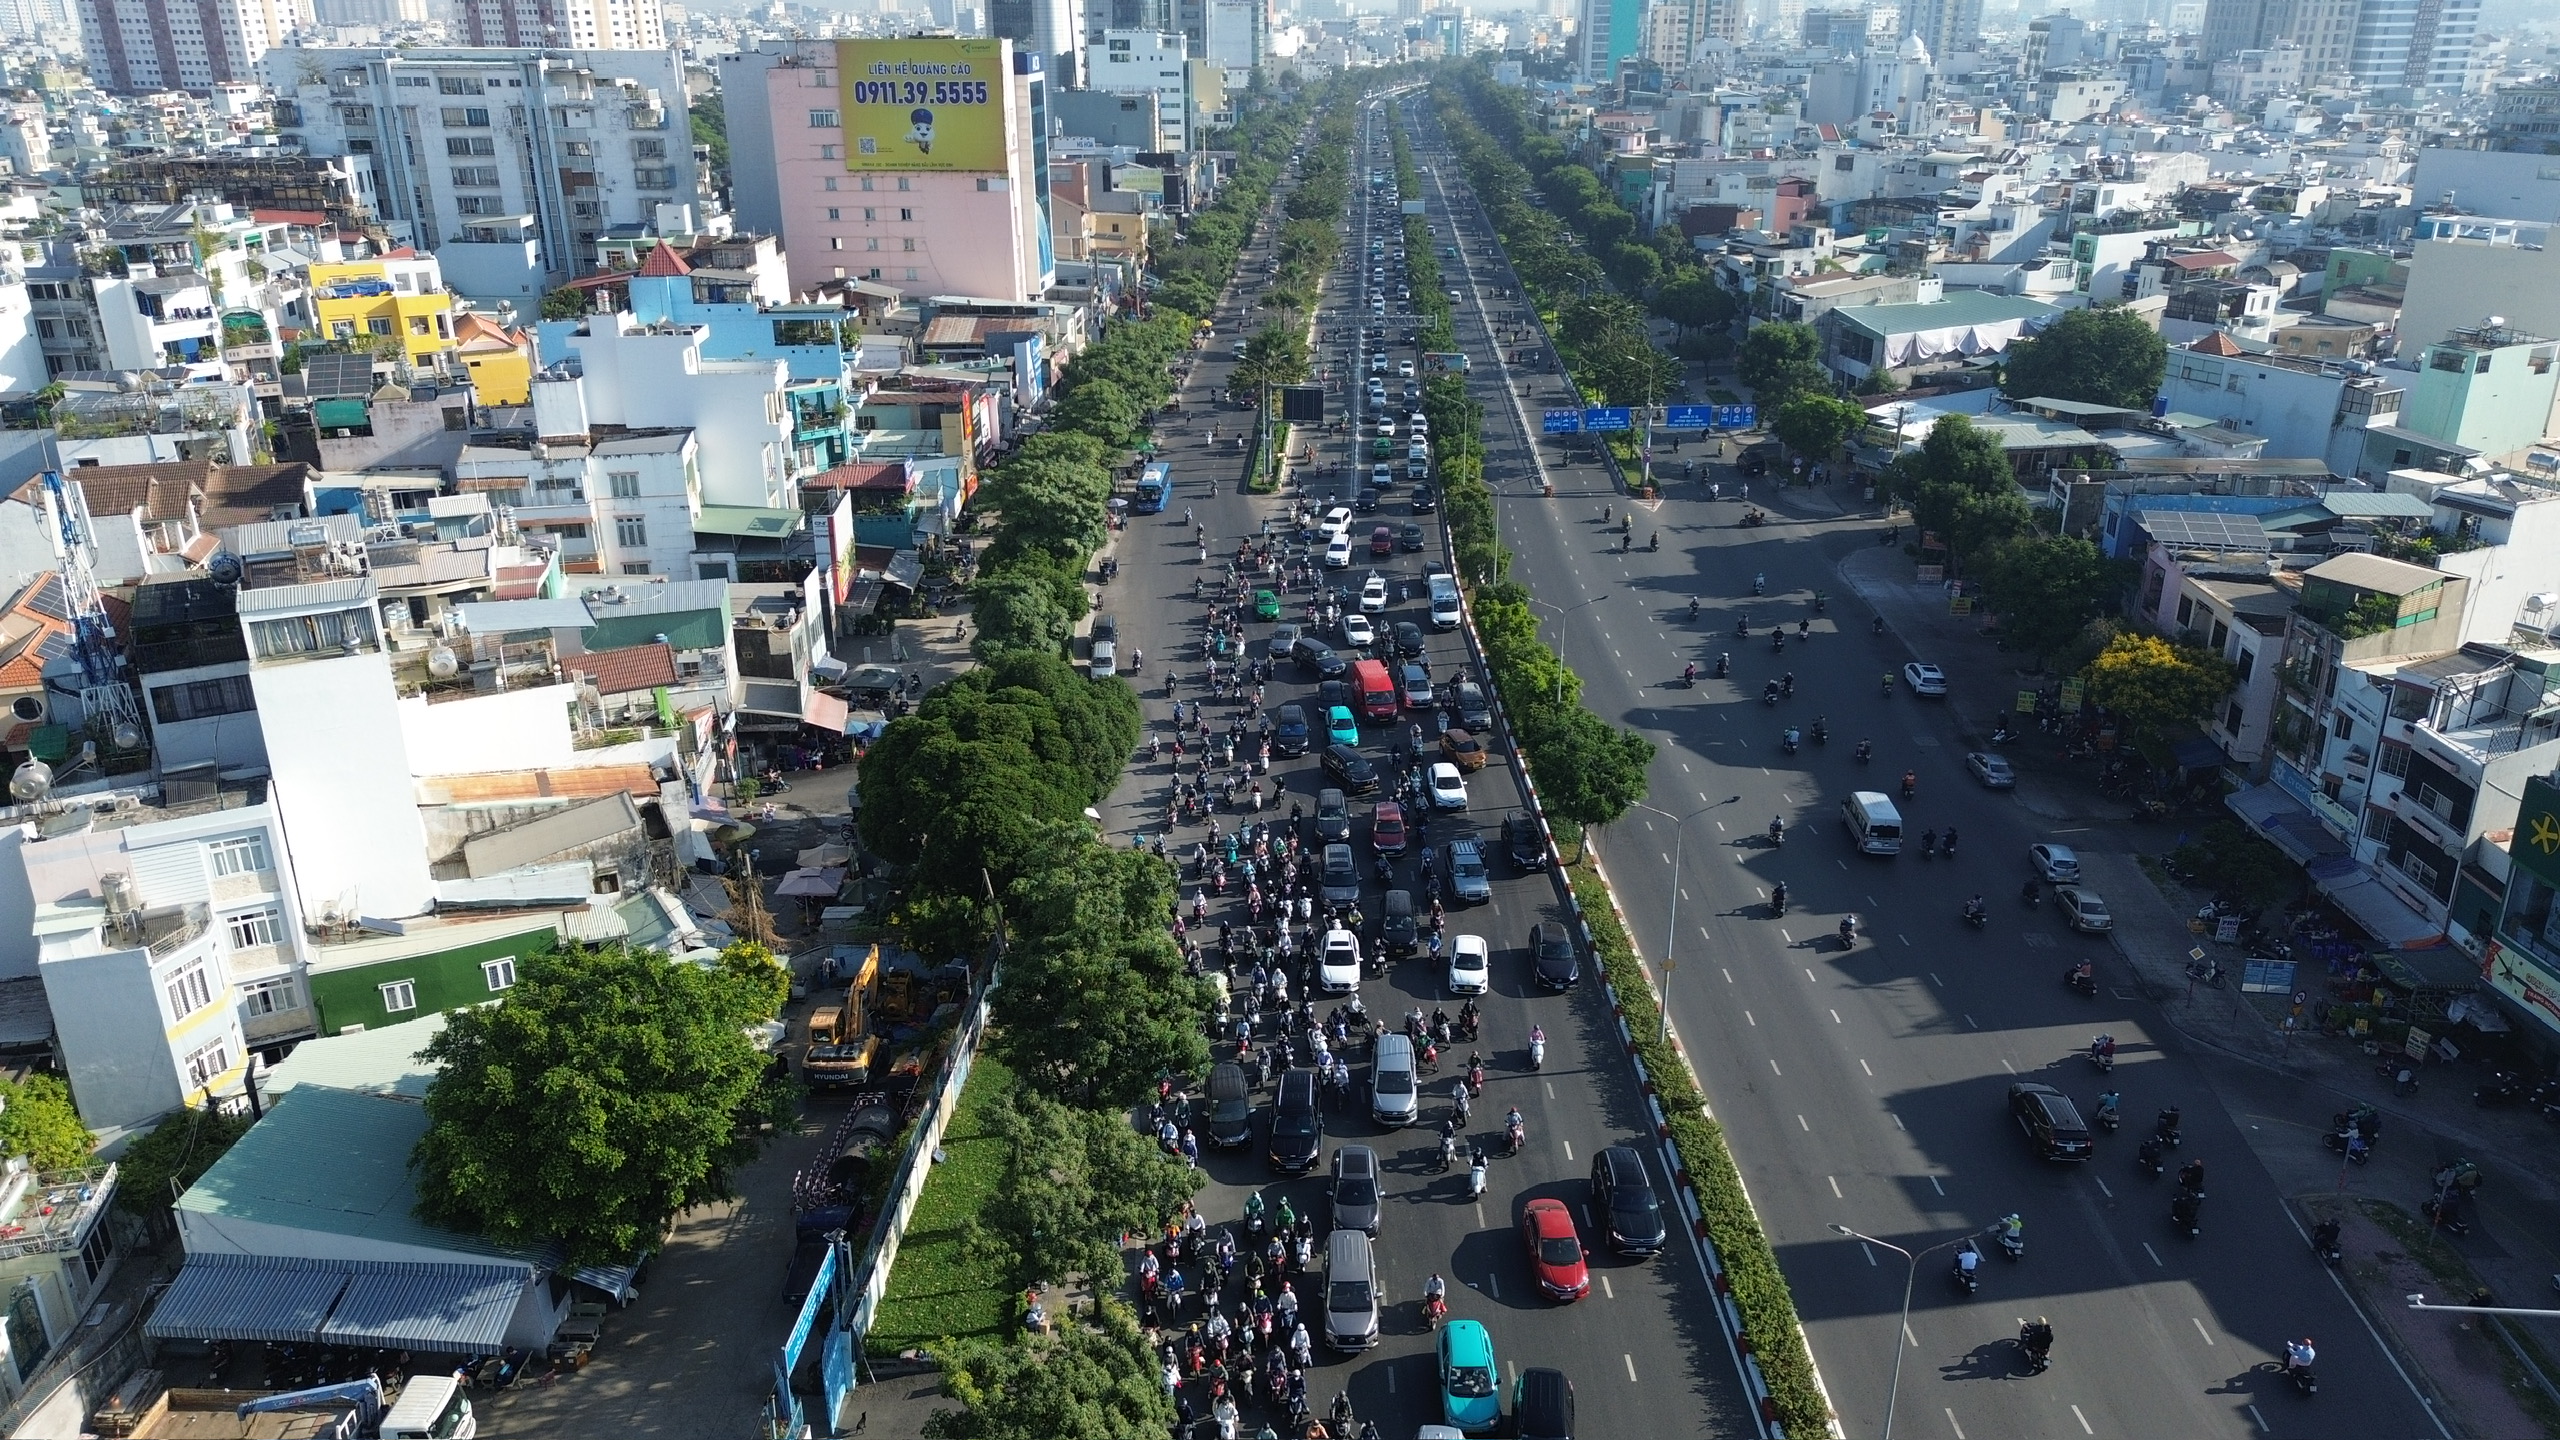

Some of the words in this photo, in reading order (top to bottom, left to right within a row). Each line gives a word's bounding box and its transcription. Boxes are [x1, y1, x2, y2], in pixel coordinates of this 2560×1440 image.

[868, 60, 891, 75] LIÊN
[895, 61, 908, 78] HỆ
[912, 60, 947, 76] QUẢNG
[951, 61, 972, 75] CÁO
[855, 80, 988, 104] 0911.39.5555
